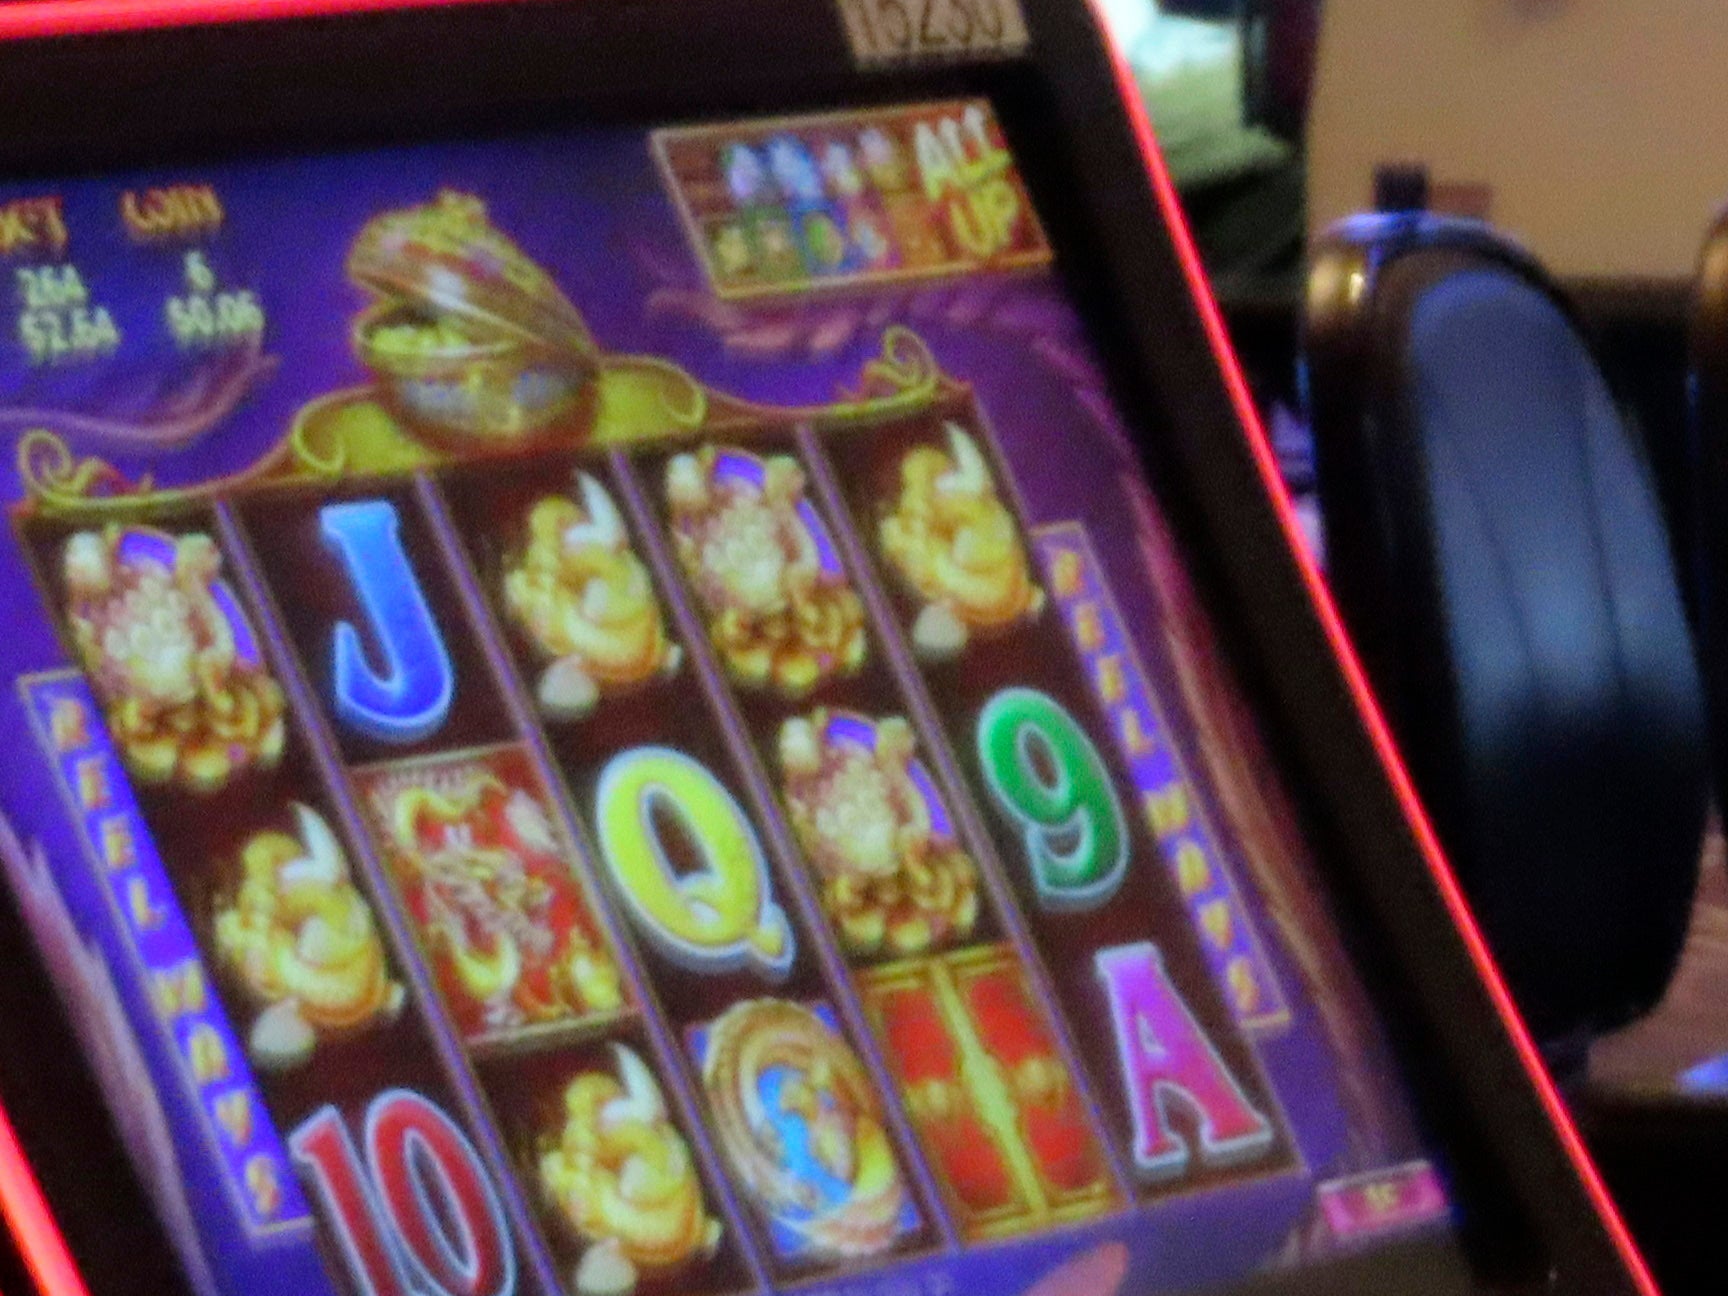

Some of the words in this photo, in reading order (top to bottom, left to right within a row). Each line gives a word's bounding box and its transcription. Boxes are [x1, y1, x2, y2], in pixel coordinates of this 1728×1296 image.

[913, 104, 1015, 204] ALL
[320, 500, 456, 742] J
[595, 746, 794, 978] Q
[978, 686, 1130, 909] 9
[1093, 941, 1275, 1180] A
